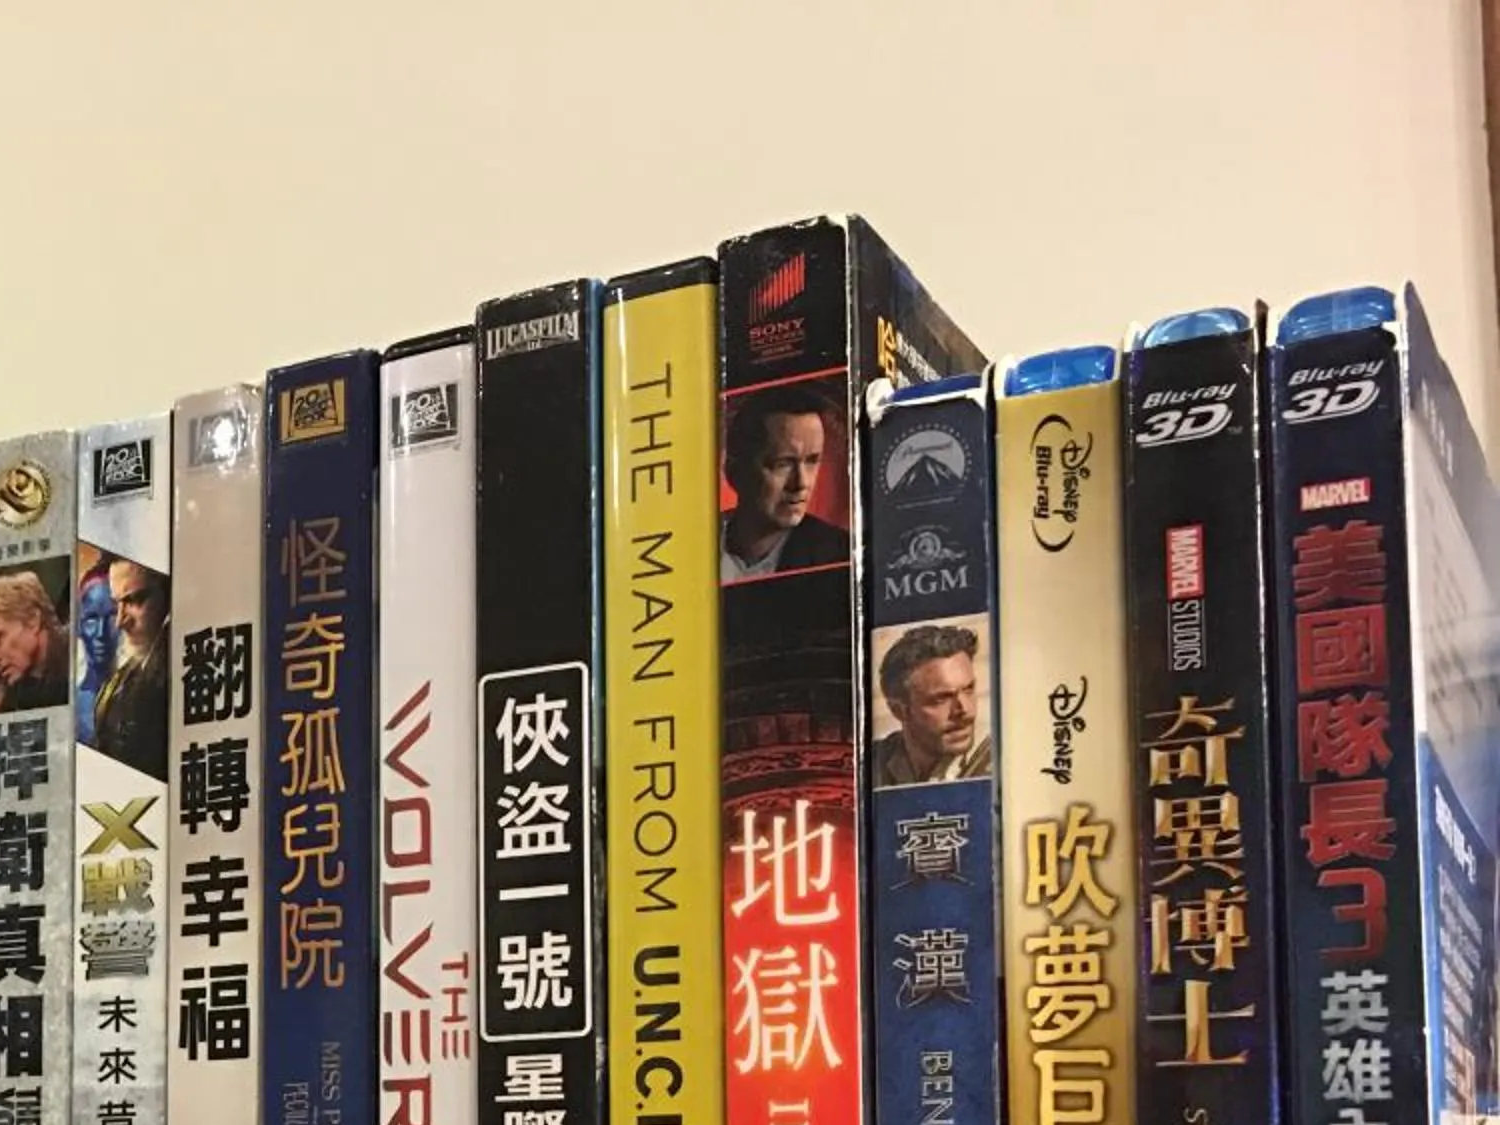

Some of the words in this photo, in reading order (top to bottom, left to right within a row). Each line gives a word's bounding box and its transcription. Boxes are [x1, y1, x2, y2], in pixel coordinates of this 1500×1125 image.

[486, 311, 581, 360] LUCASFILM
[749, 317, 806, 339] SONY
[1143, 382, 1236, 409] Blu-ray
[1283, 380, 1381, 422] 3D
[1289, 358, 1382, 387] Blu-ray
[627, 360, 674, 504] THE
[1136, 403, 1233, 447] 3D
[1032, 445, 1052, 520] Blu-ray
[1302, 479, 1369, 510] MARVEL
[884, 566, 969, 601] MGM
[1167, 526, 1202, 598] MARVEL
[630, 530, 676, 686] MAN
[1171, 600, 1204, 671] STUDIOS
[279, 515, 349, 991] 怪奇孤兒院
[1039, 675, 1088, 785] Disney
[178, 623, 254, 1062] 翻轉幸福
[632, 714, 681, 913] FROM
[495, 695, 574, 1012] 俠盜一號
[1139, 694, 1255, 1068] 奇異博士
[729, 798, 843, 1076] 地獄
[890, 811, 976, 1010] 賓漢
[440, 951, 471, 1061] THE
[321, 1040, 342, 1102] MISS
